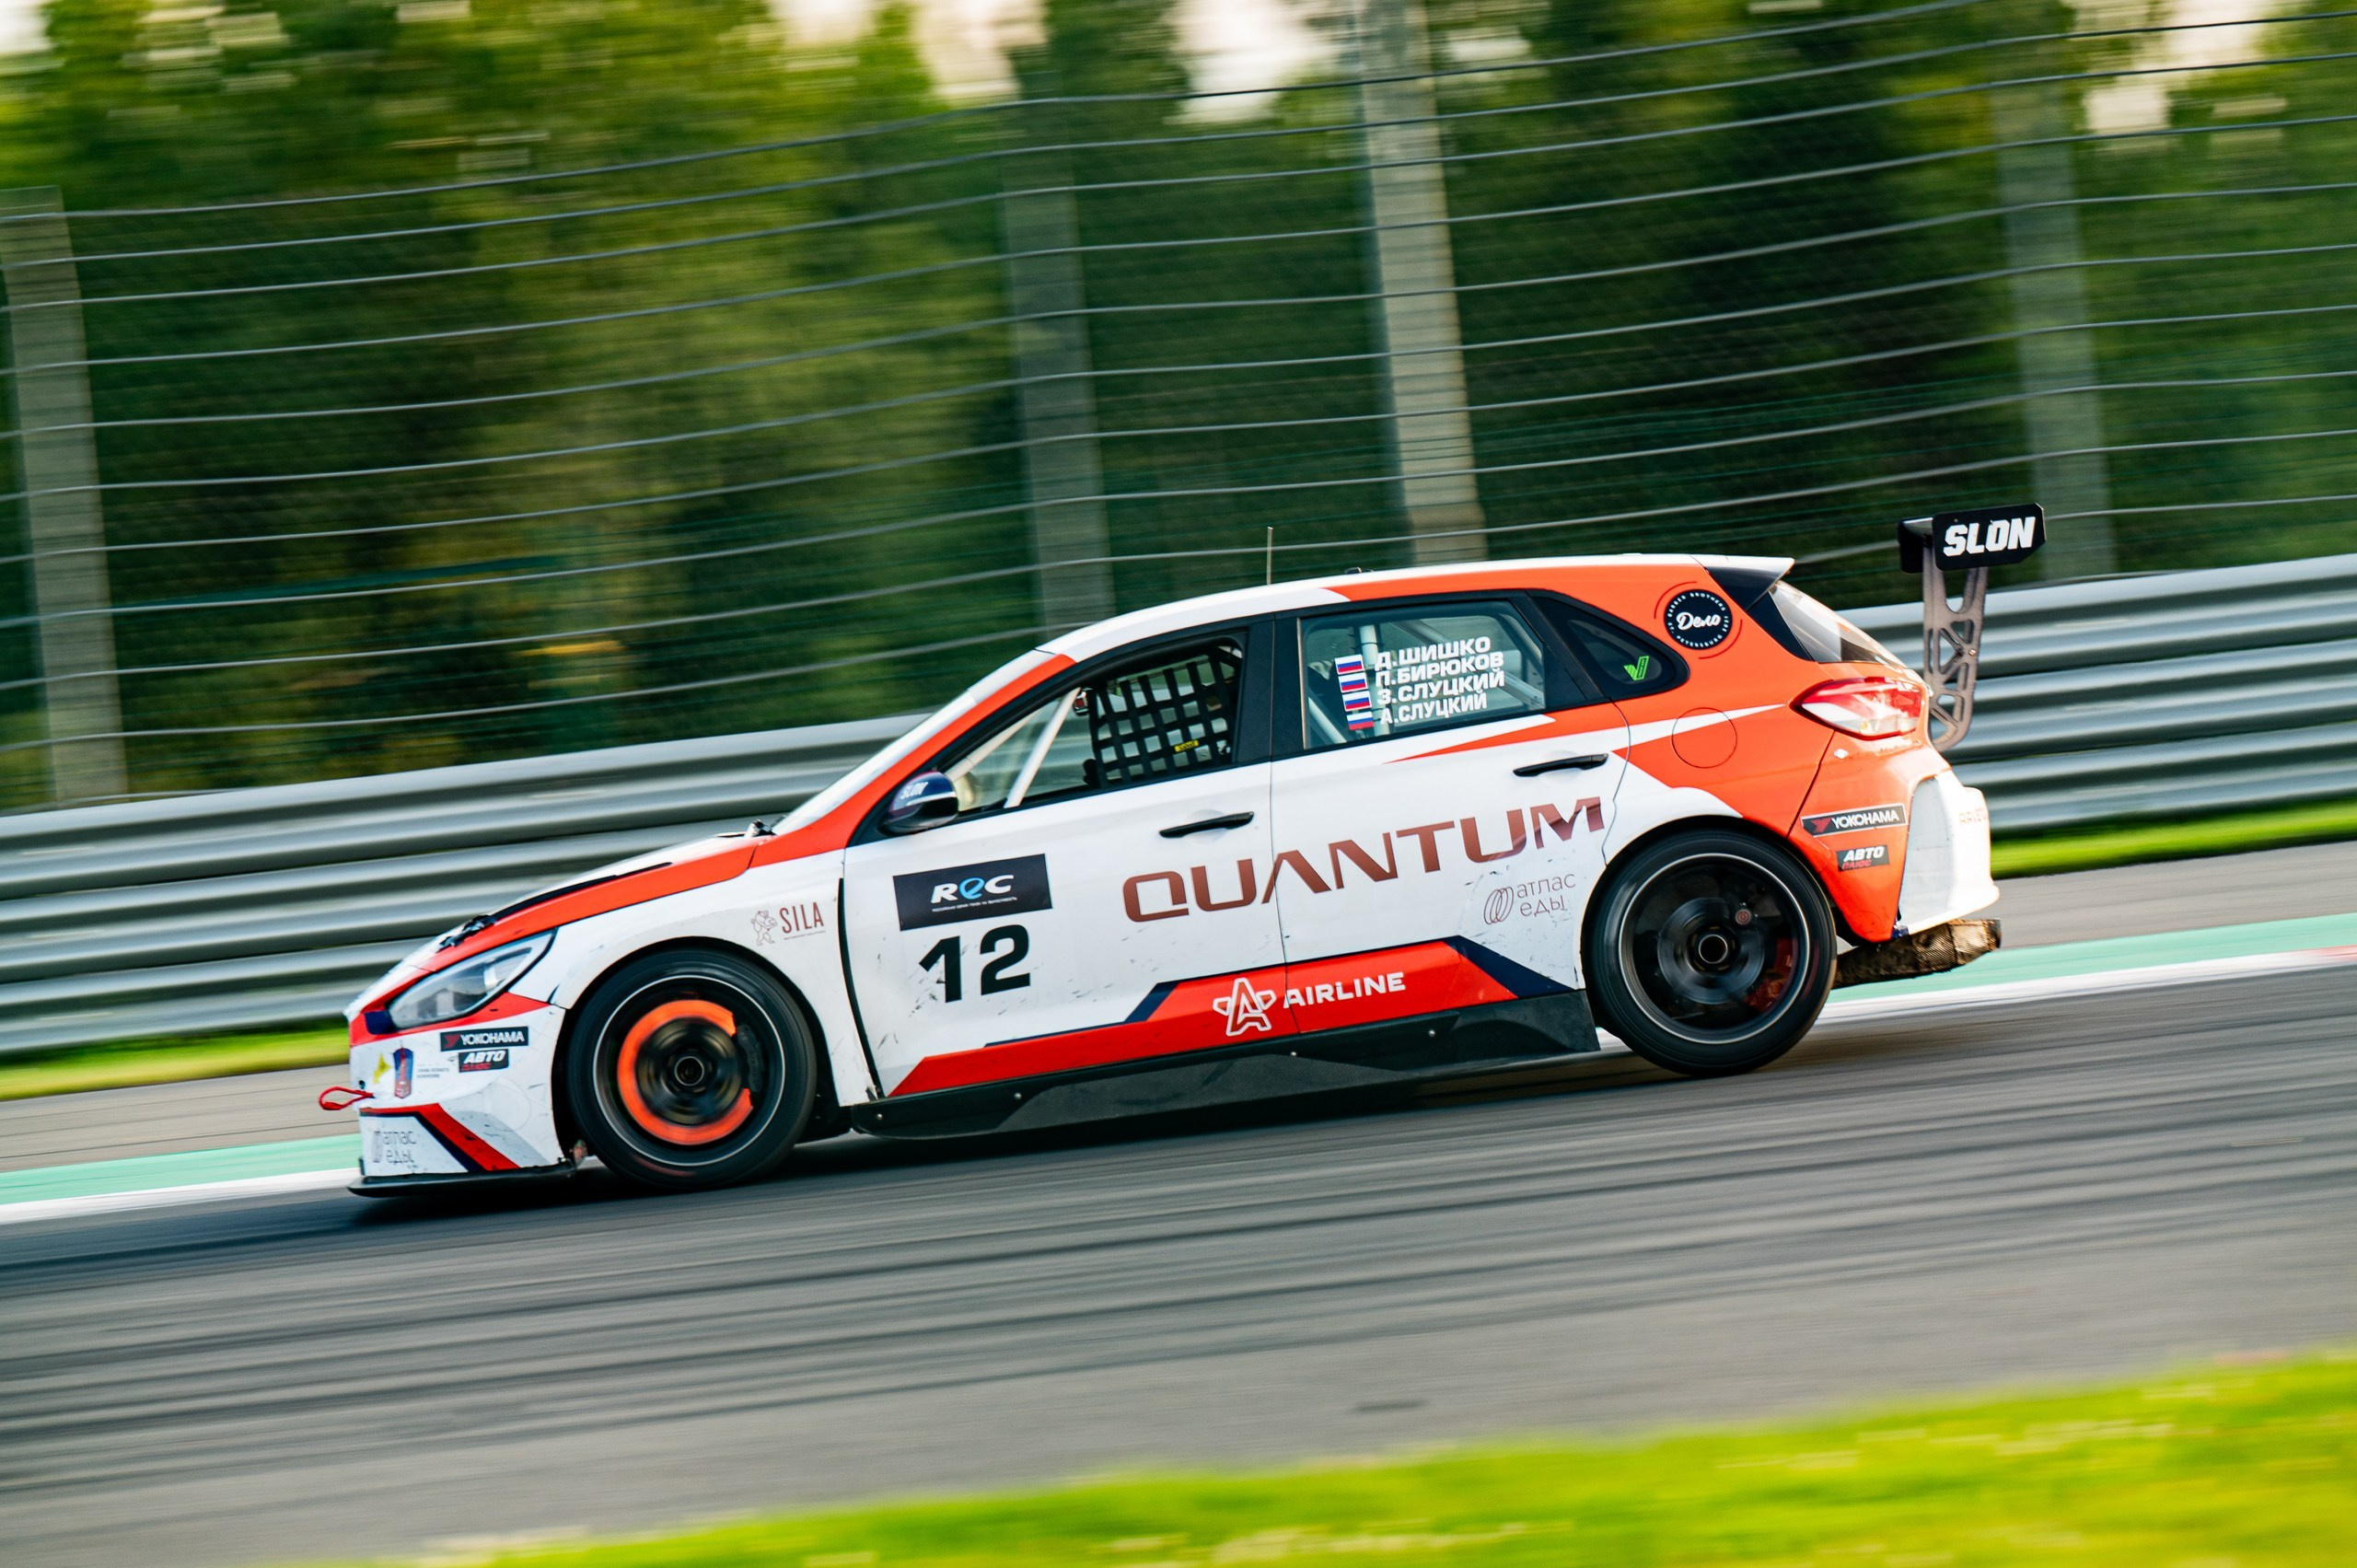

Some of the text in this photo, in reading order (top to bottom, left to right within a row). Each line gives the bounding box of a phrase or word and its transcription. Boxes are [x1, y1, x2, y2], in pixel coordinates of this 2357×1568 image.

[1943, 516, 2036, 557] SLON
[1375, 636, 1491, 671] Д.ШИШКО
[1376, 651, 1504, 687] П.БИРЮКОВ
[1377, 668, 1505, 705] З.СЛУЦКИЙ
[1380, 689, 1488, 725] А.СЛУЦКИЙ
[1831, 809, 1900, 829] YOKOHAMA
[1121, 796, 1605, 923] QUANTUM
[1842, 845, 1886, 862] АВТО
[1516, 874, 1576, 899] атлас
[779, 901, 825, 934] SILA
[1520, 895, 1568, 917] еды
[919, 924, 1030, 1003] 12
[1283, 971, 1406, 1009] AIRLINE
[460, 1030, 526, 1046] YOKOHAMA
